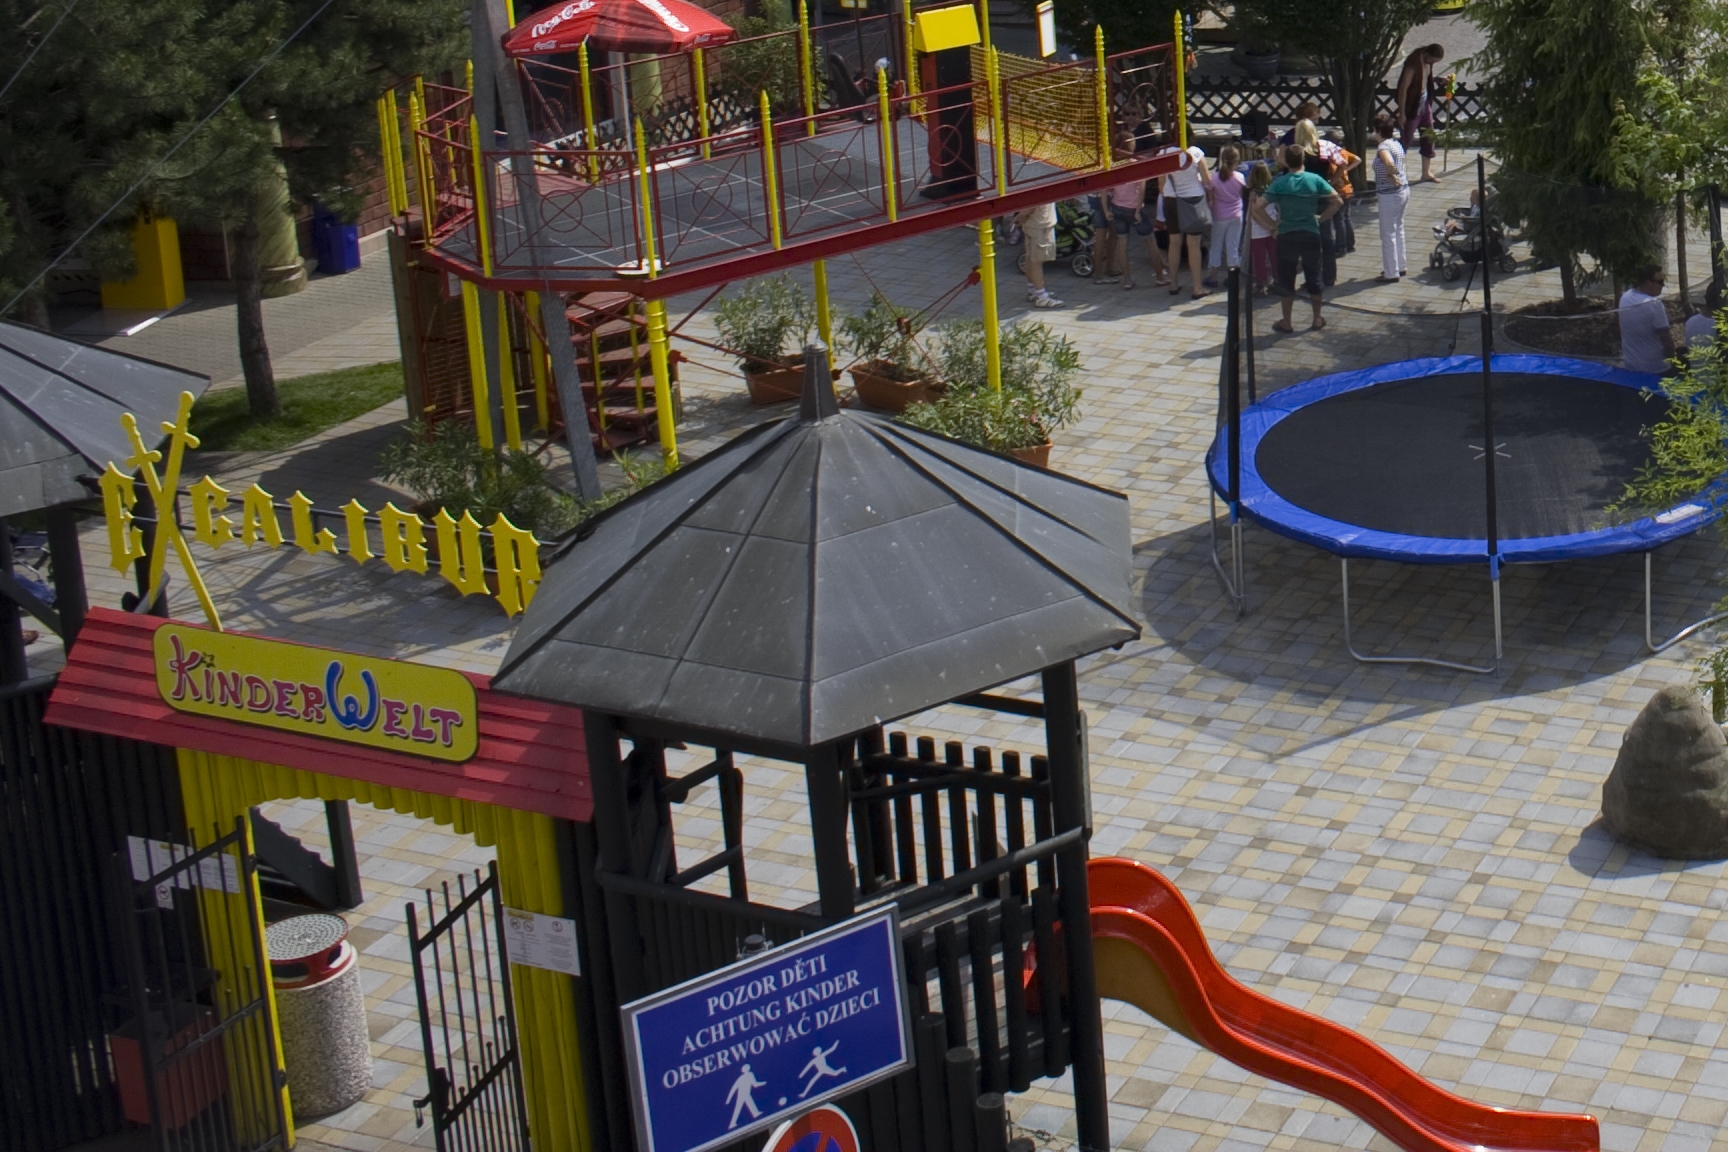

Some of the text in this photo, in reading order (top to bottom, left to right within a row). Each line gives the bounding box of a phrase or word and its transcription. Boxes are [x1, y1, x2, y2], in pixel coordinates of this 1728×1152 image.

[99, 391, 541, 632] EXCALIBUR
[681, 969, 861, 1056] ACHTUNG KINDER
[707, 954, 828, 1017] POZOR DĚTI
[662, 987, 882, 1090] OBSERWOWAĆ DZIECI
